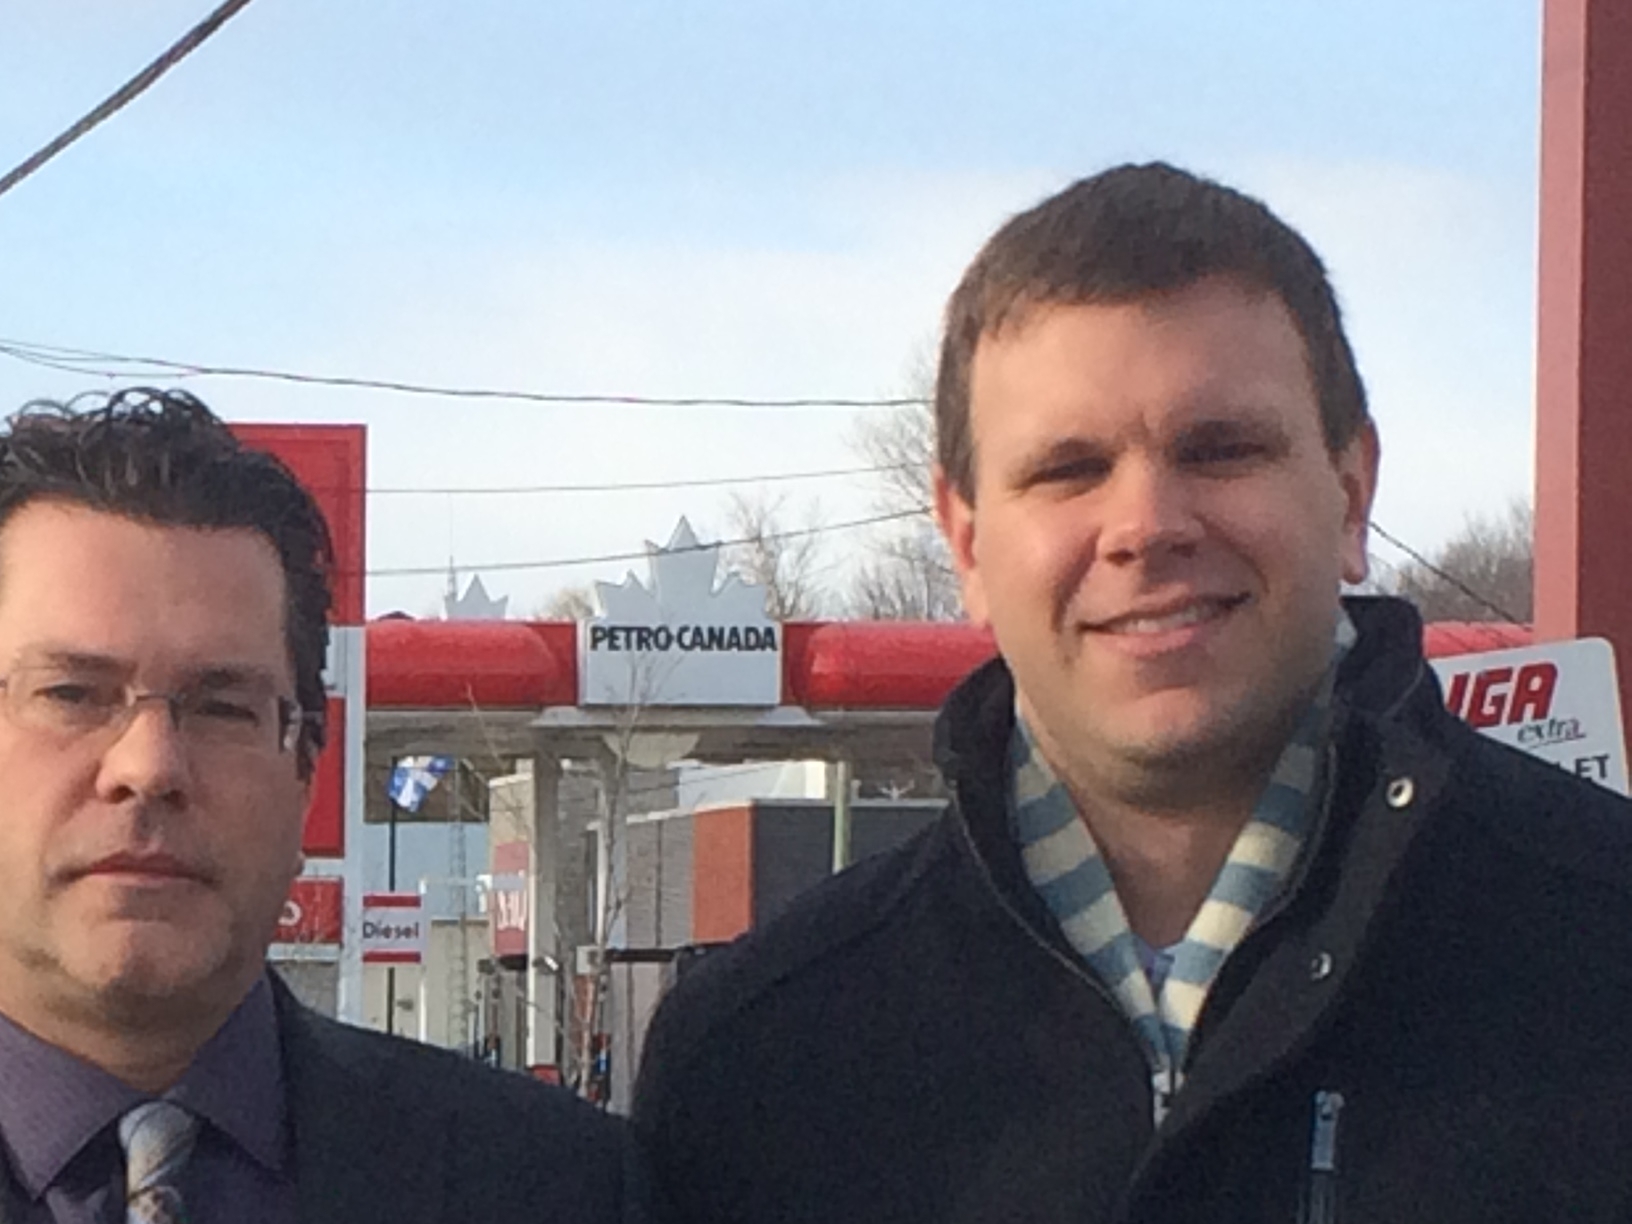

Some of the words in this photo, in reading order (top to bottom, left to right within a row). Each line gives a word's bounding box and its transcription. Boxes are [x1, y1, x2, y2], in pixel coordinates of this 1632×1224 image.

[1446, 662, 1558, 731] IGA
[1517, 718, 1584, 744] extra
[1555, 753, 1610, 779] ET
